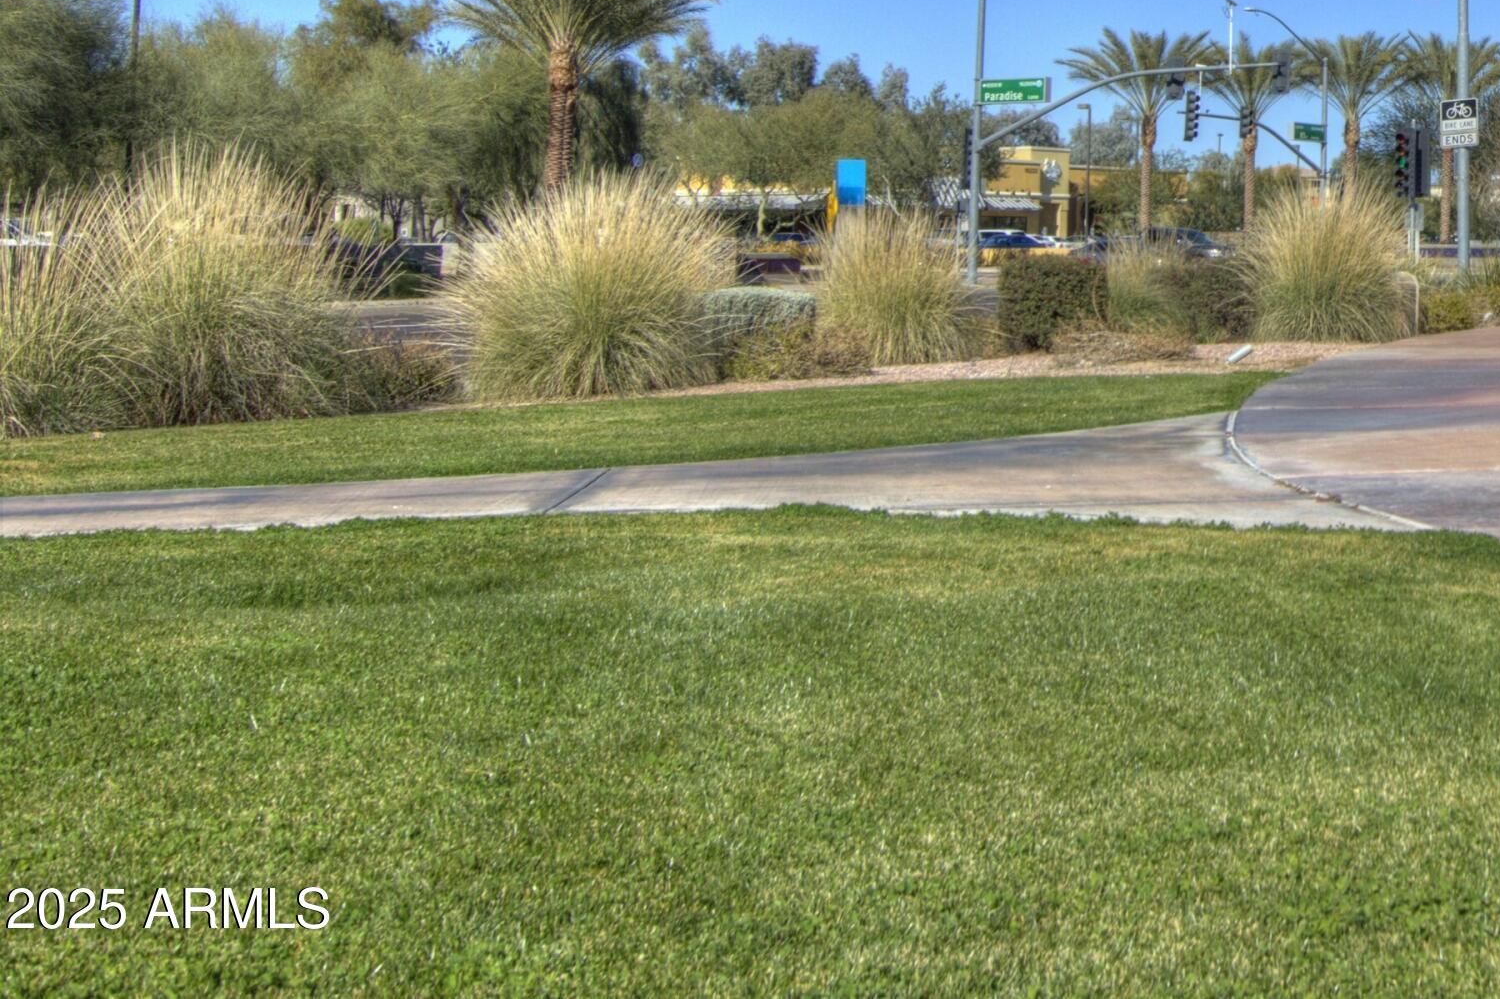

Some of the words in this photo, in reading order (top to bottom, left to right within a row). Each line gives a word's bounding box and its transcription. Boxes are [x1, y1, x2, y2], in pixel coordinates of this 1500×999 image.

[984, 91, 1023, 101] Paradise
[1459, 120, 1475, 129] LANE
[1445, 134, 1475, 146] ENDS
